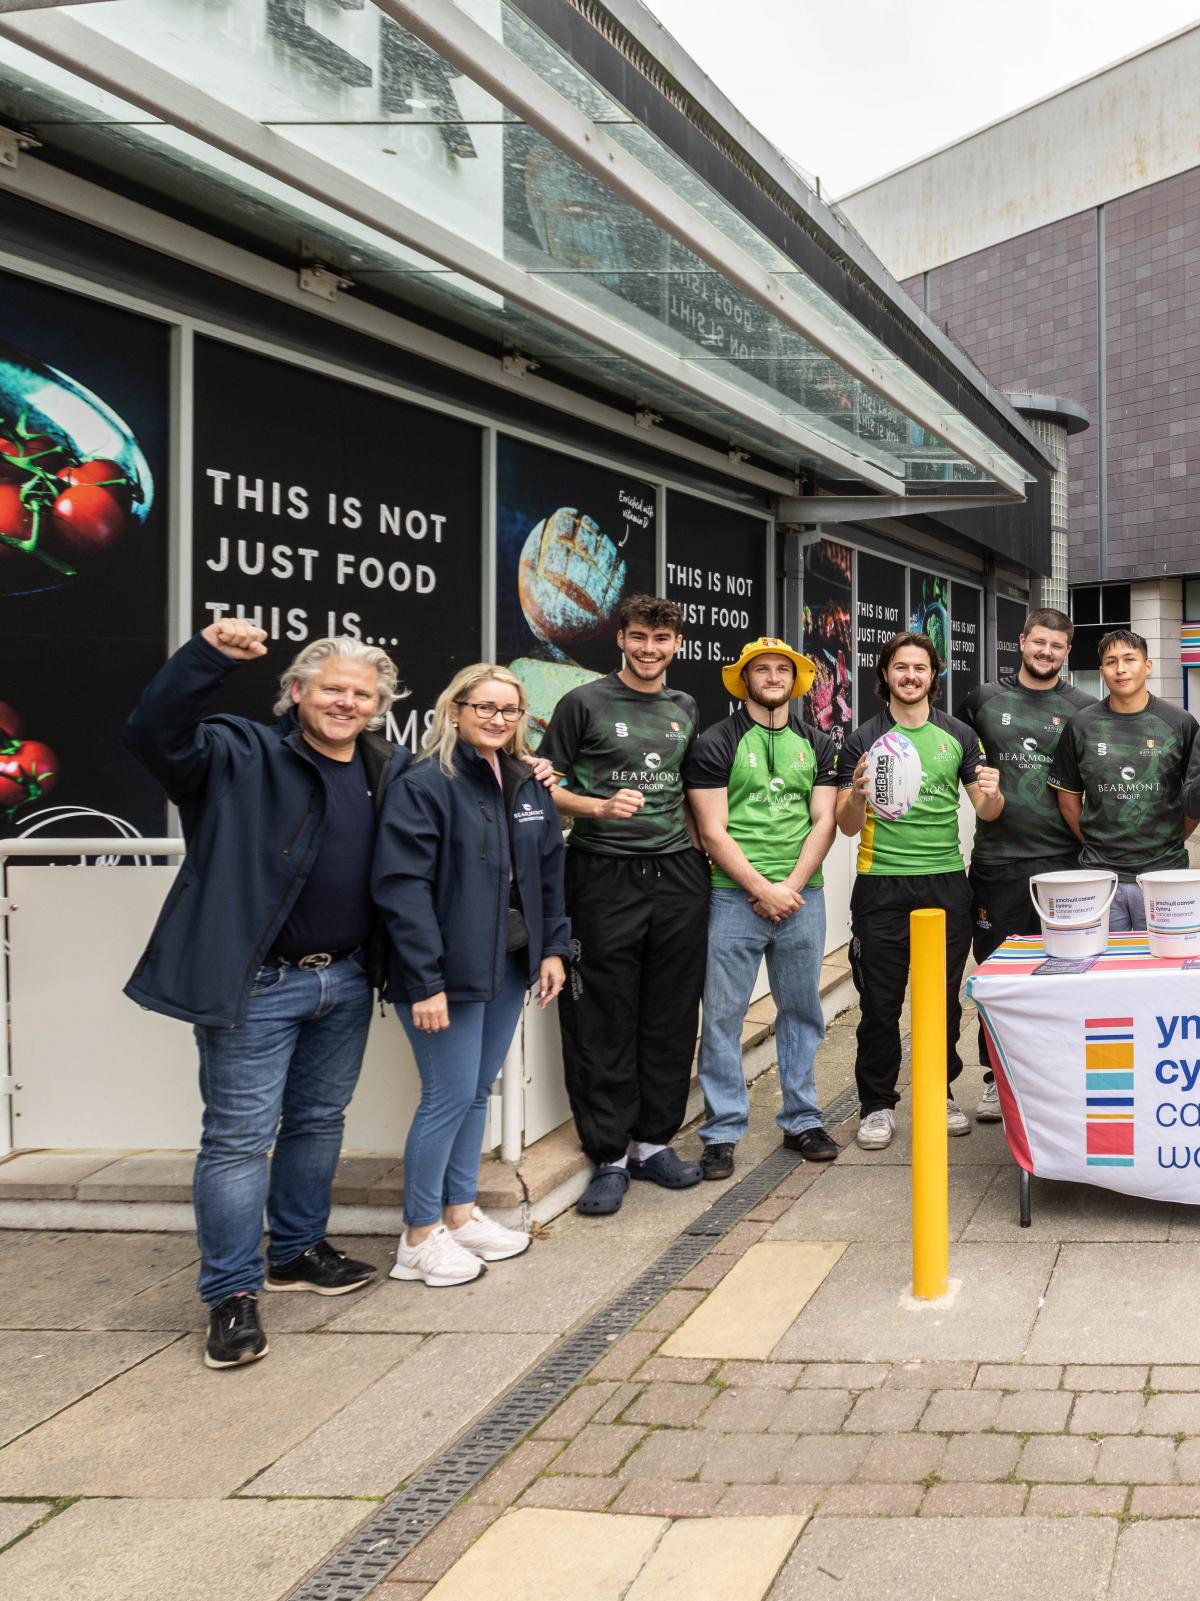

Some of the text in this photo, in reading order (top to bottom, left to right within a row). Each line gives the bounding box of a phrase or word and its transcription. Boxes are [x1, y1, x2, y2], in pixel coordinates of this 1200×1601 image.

[206, 467, 447, 543] THIS IS NOT
[206, 537, 436, 594] JUST FOOD
[667, 563, 753, 597] THIS IS NOT
[711, 606, 749, 630] FOOD
[857, 601, 874, 619] THIS
[876, 606, 883, 621] IS
[885, 608, 899, 622] NOT
[205, 602, 309, 642] THIS
[950, 619, 976, 636] THIS IS NOT
[857, 628, 876, 643] JUST
[677, 640, 735, 662] HIS IS...
[962, 641, 975, 653] FOOD
[857, 653, 873, 667] THIS
[950, 659, 961, 671] THIS
[999, 752, 1055, 764] BEARMON
[611, 770, 680, 784] BEARMONT
[1098, 782, 1160, 793] BEARMONT
